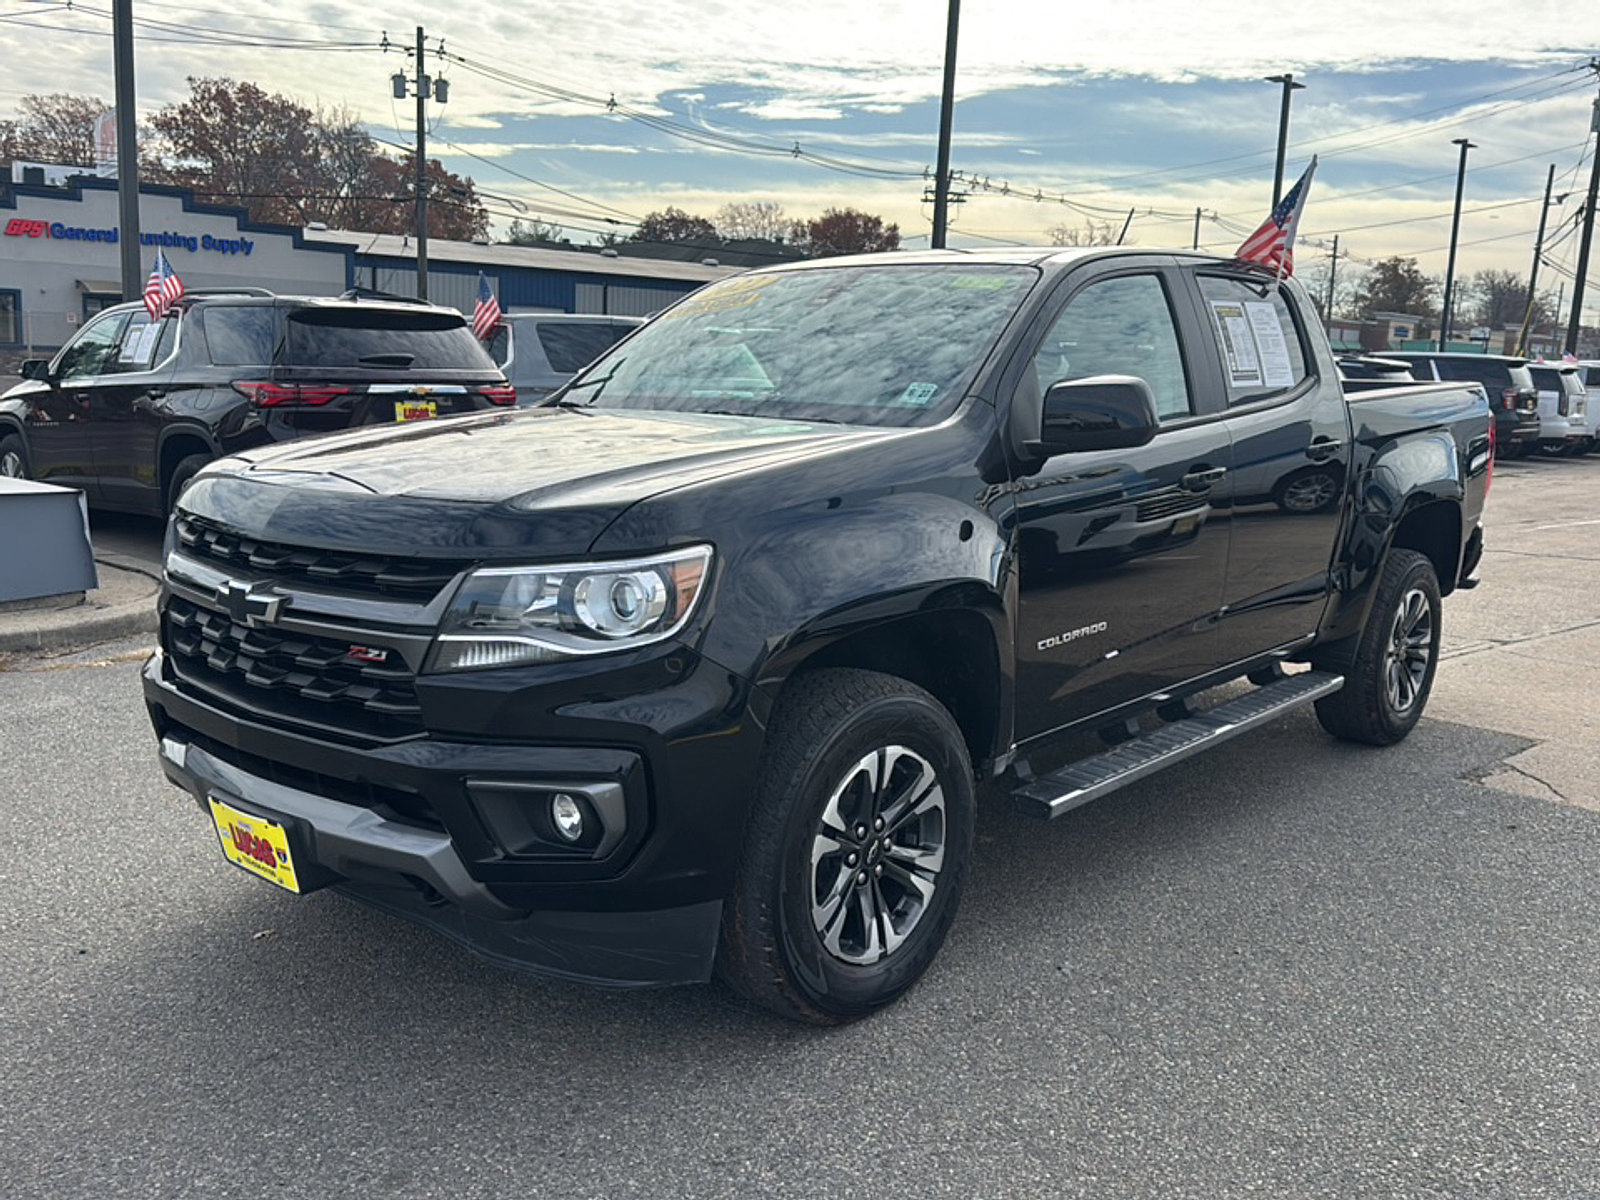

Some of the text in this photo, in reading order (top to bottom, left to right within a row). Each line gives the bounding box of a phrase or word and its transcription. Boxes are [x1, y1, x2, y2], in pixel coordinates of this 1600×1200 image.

[5, 219, 255, 256] GPS General umbing Supply
[1037, 621, 1107, 651] COLORADO
[347, 645, 387, 661] Z71
[228, 822, 277, 868] LUCAS
